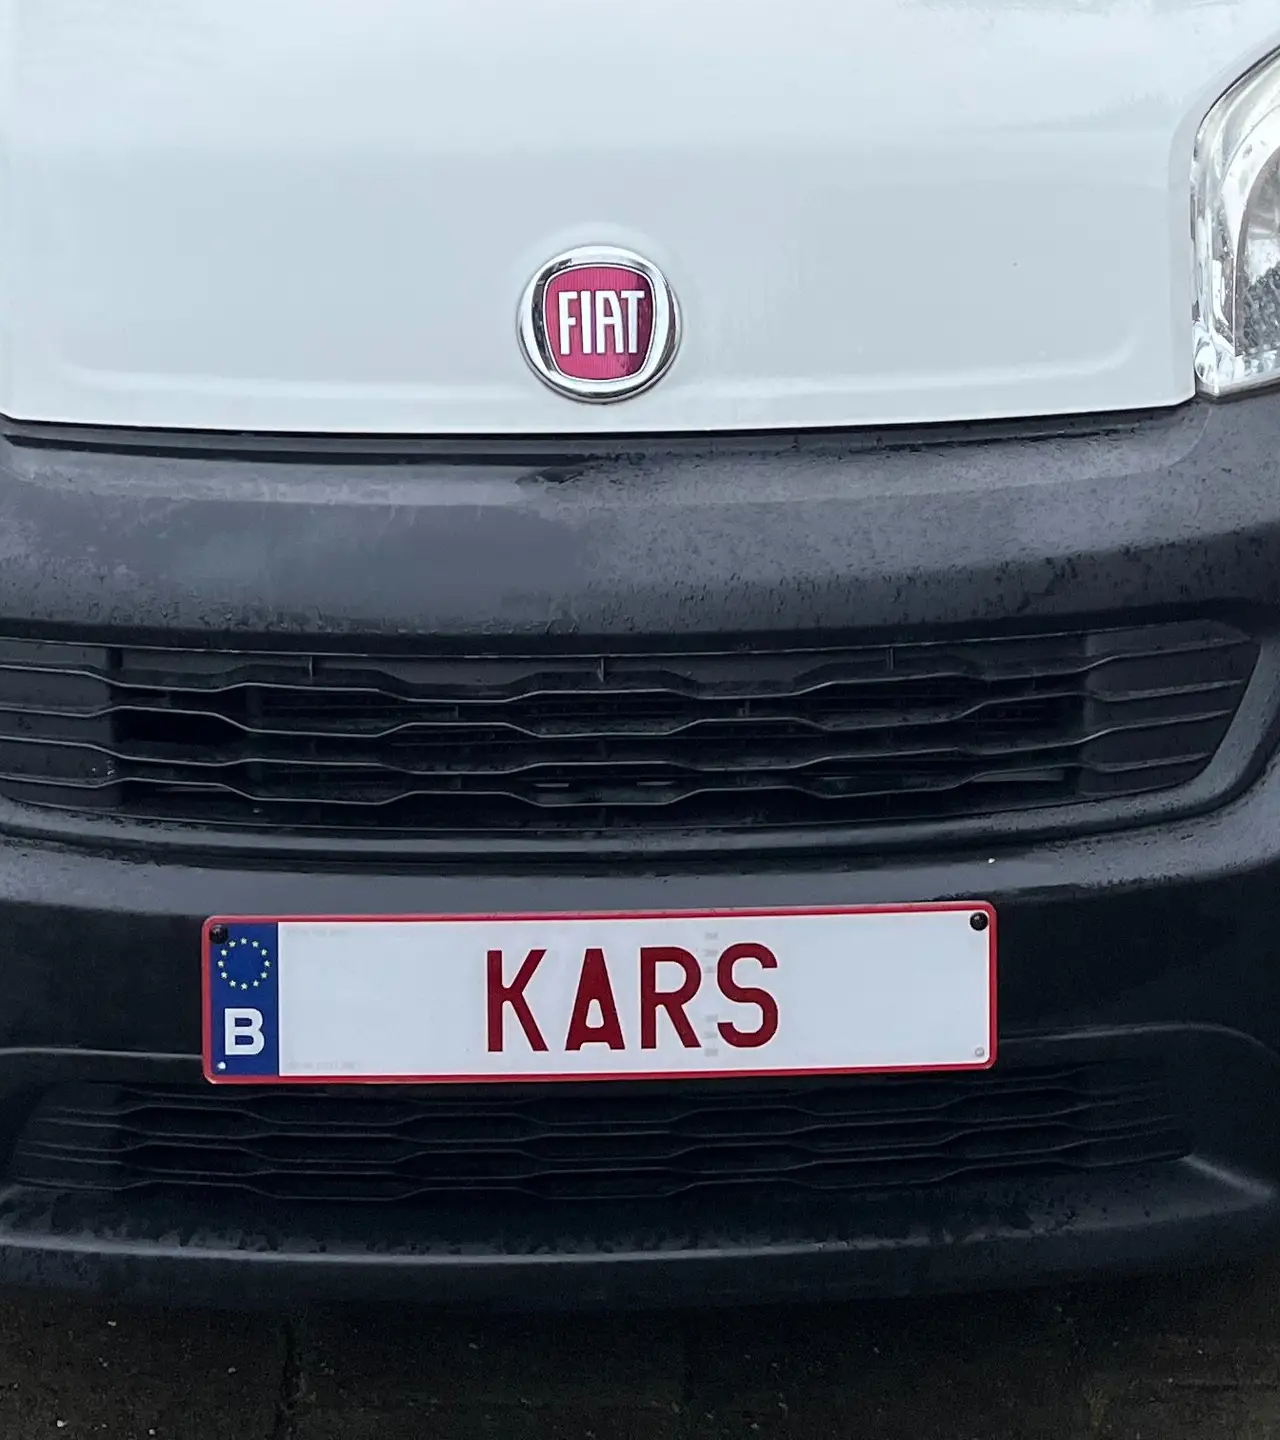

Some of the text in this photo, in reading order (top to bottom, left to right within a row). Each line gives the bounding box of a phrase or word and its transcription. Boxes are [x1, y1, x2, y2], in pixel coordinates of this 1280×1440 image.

[558, 290, 645, 356] FIAT
[486, 942, 779, 1053] KARS
[224, 1007, 265, 1056] B
